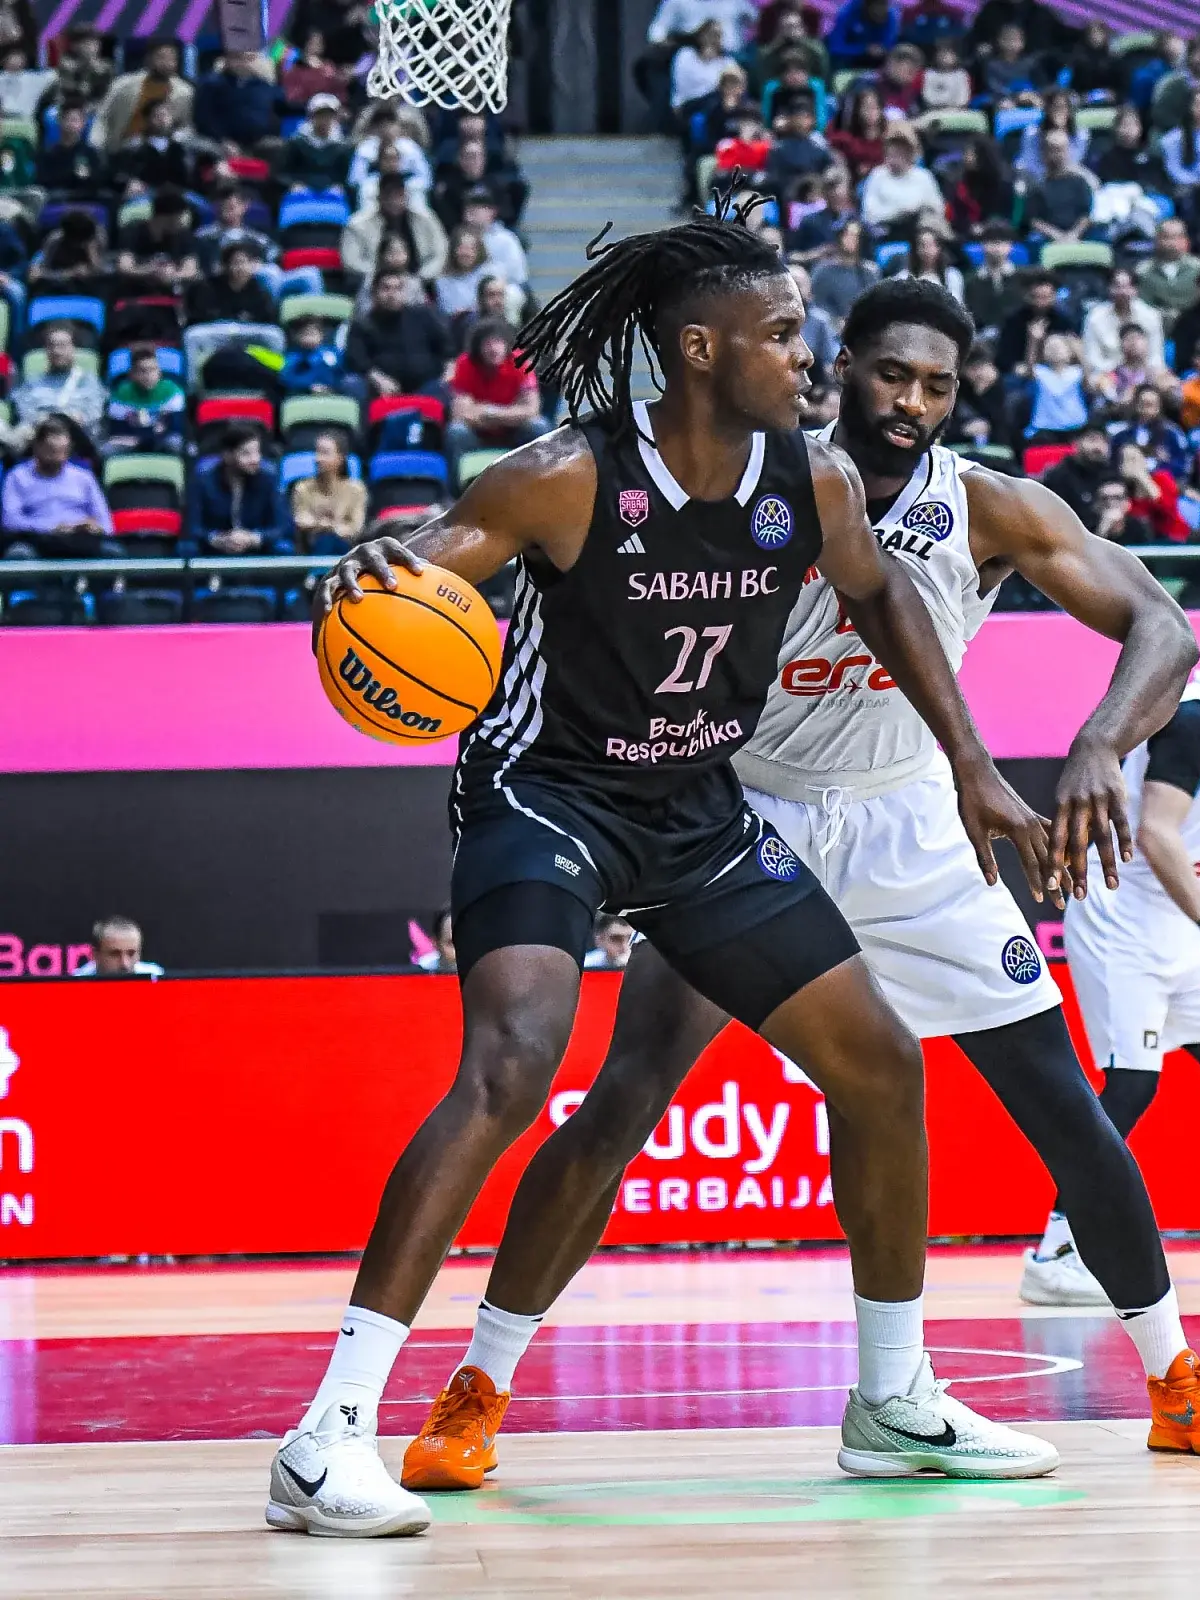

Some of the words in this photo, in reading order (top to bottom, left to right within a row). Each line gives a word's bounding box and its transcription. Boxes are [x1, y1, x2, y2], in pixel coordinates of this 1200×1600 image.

[621, 500, 646, 510] SABAH
[437, 584, 471, 614] FIBA
[628, 571, 732, 600] SABAH
[740, 566, 780, 598] BC
[654, 624, 734, 694] 27
[339, 647, 443, 733] Wilson
[606, 718, 744, 764] Respublika
[649, 708, 708, 740] Bank
